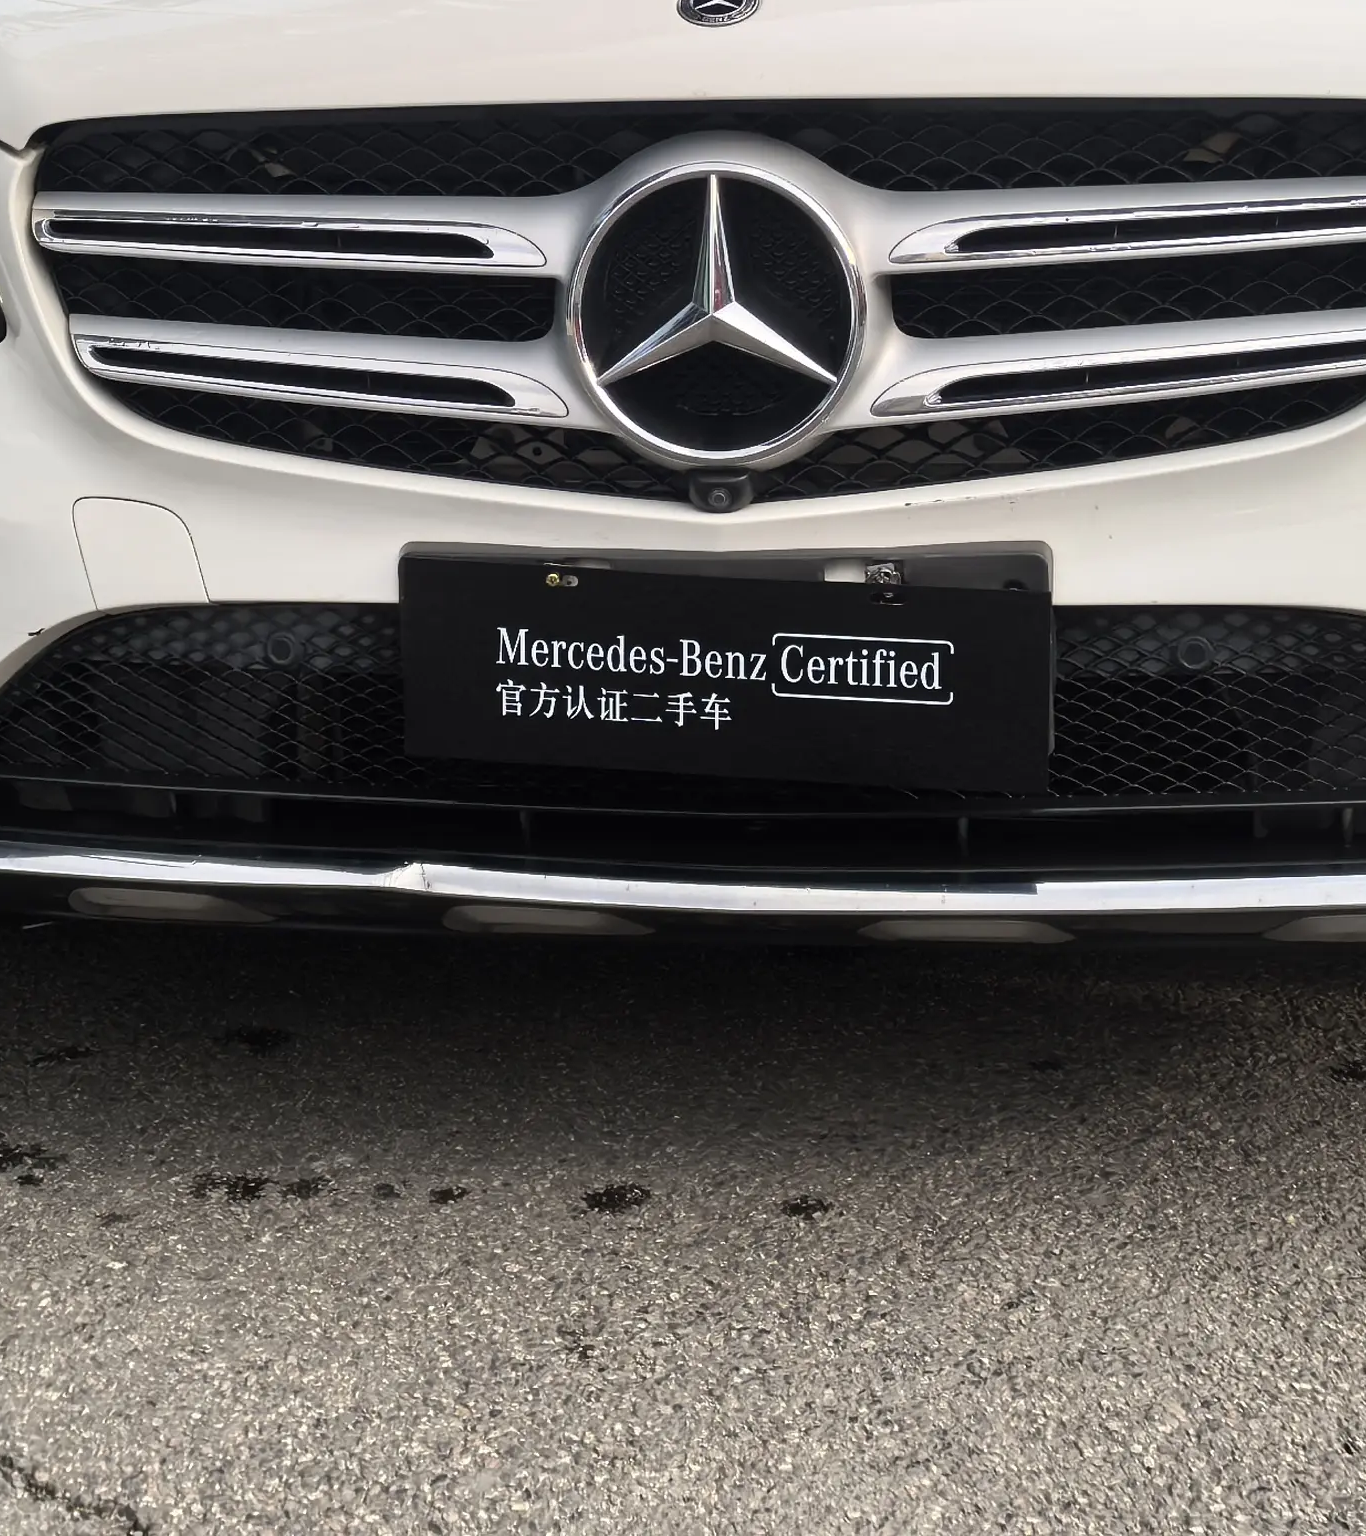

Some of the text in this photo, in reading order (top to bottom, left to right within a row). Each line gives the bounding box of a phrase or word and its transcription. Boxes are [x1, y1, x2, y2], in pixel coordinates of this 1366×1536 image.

[496, 626, 943, 690] Mercedes-Benz Certified
[495, 678, 733, 731] 官方认证二手车
